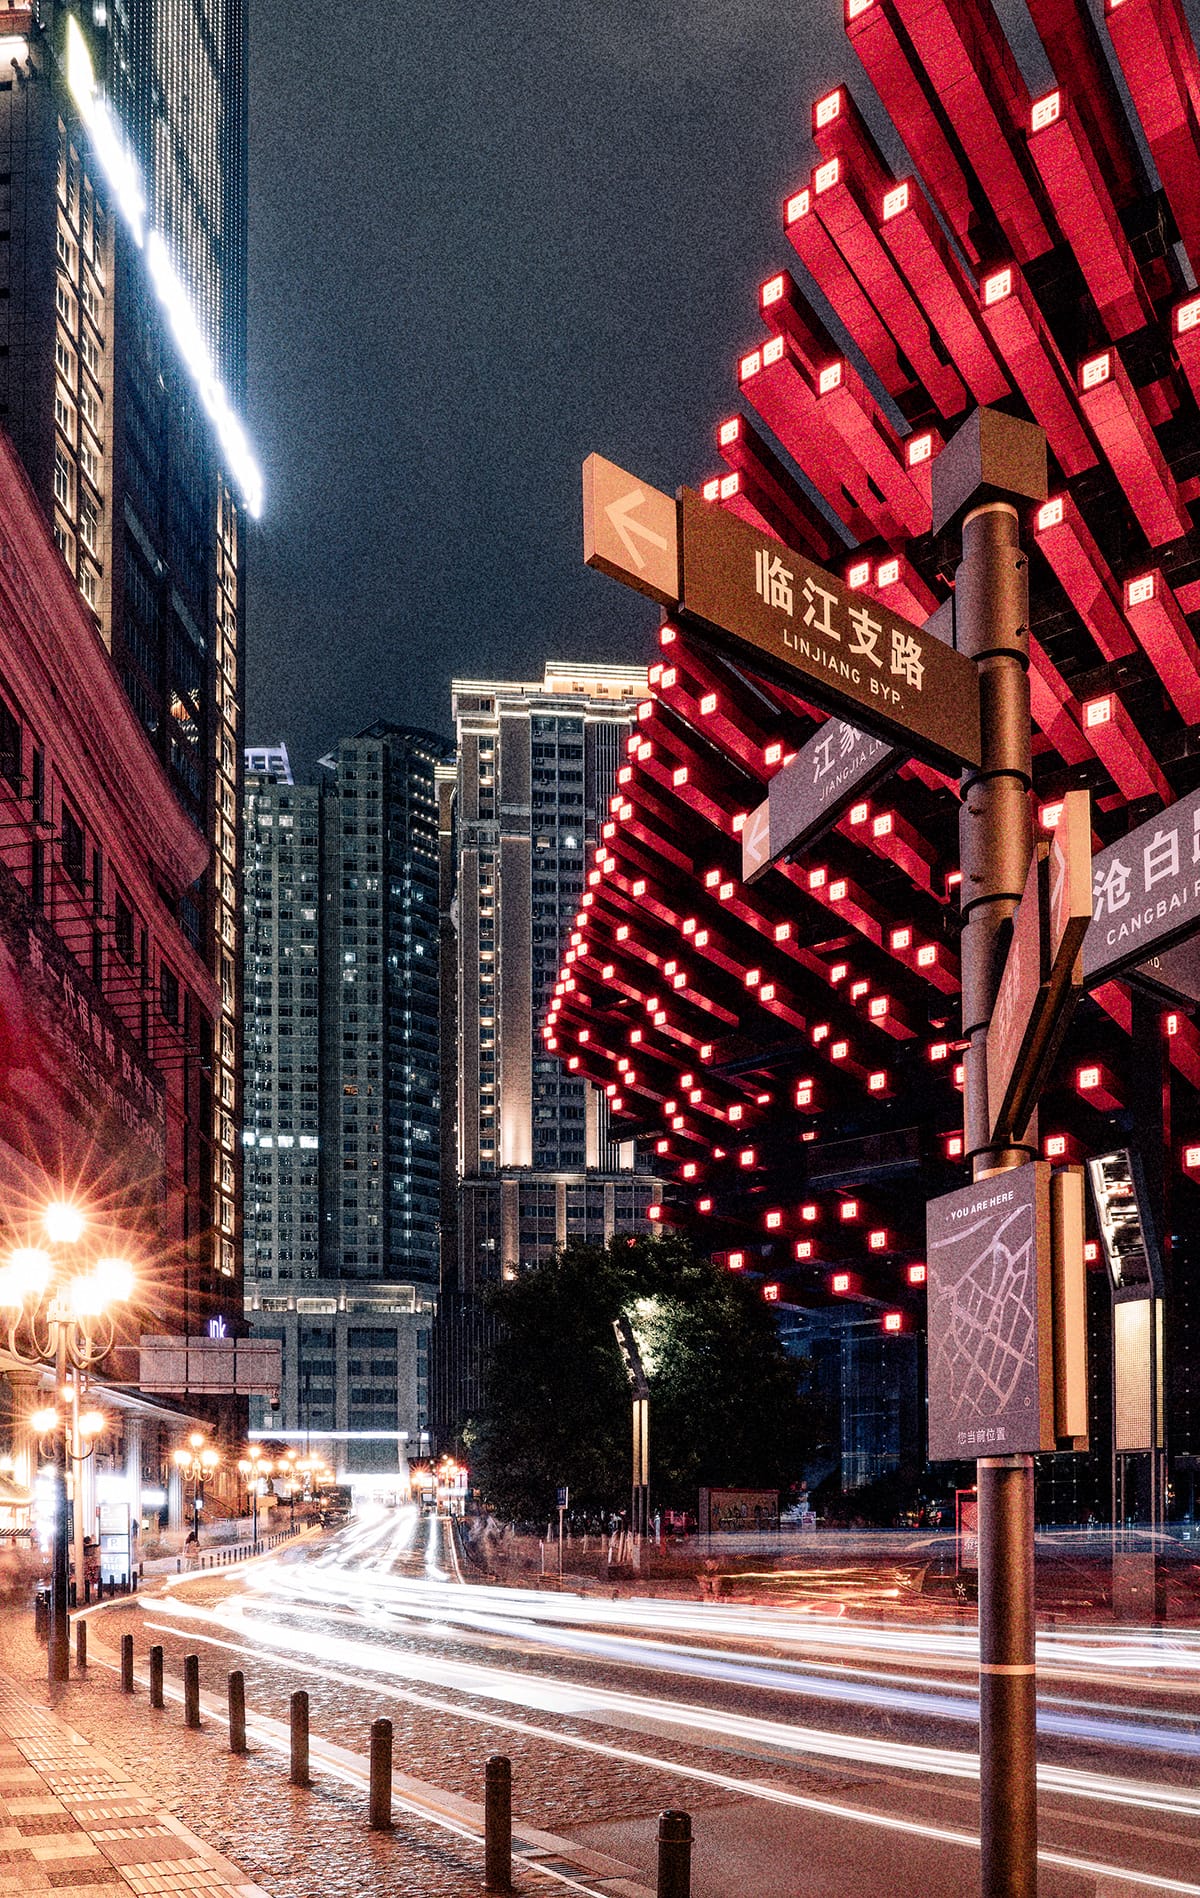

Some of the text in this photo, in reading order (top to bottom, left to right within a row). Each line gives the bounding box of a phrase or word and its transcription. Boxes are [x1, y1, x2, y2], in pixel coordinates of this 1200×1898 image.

[755, 549, 926, 692] 临江支路
[783, 629, 905, 710] LINJIANG BYP.
[819, 751, 867, 802] JIANGJIA
[1106, 887, 1188, 946] CANGBAI
[951, 1190, 1014, 1221] YOU ARE HERE
[957, 1426, 1006, 1445] 您当前位置
